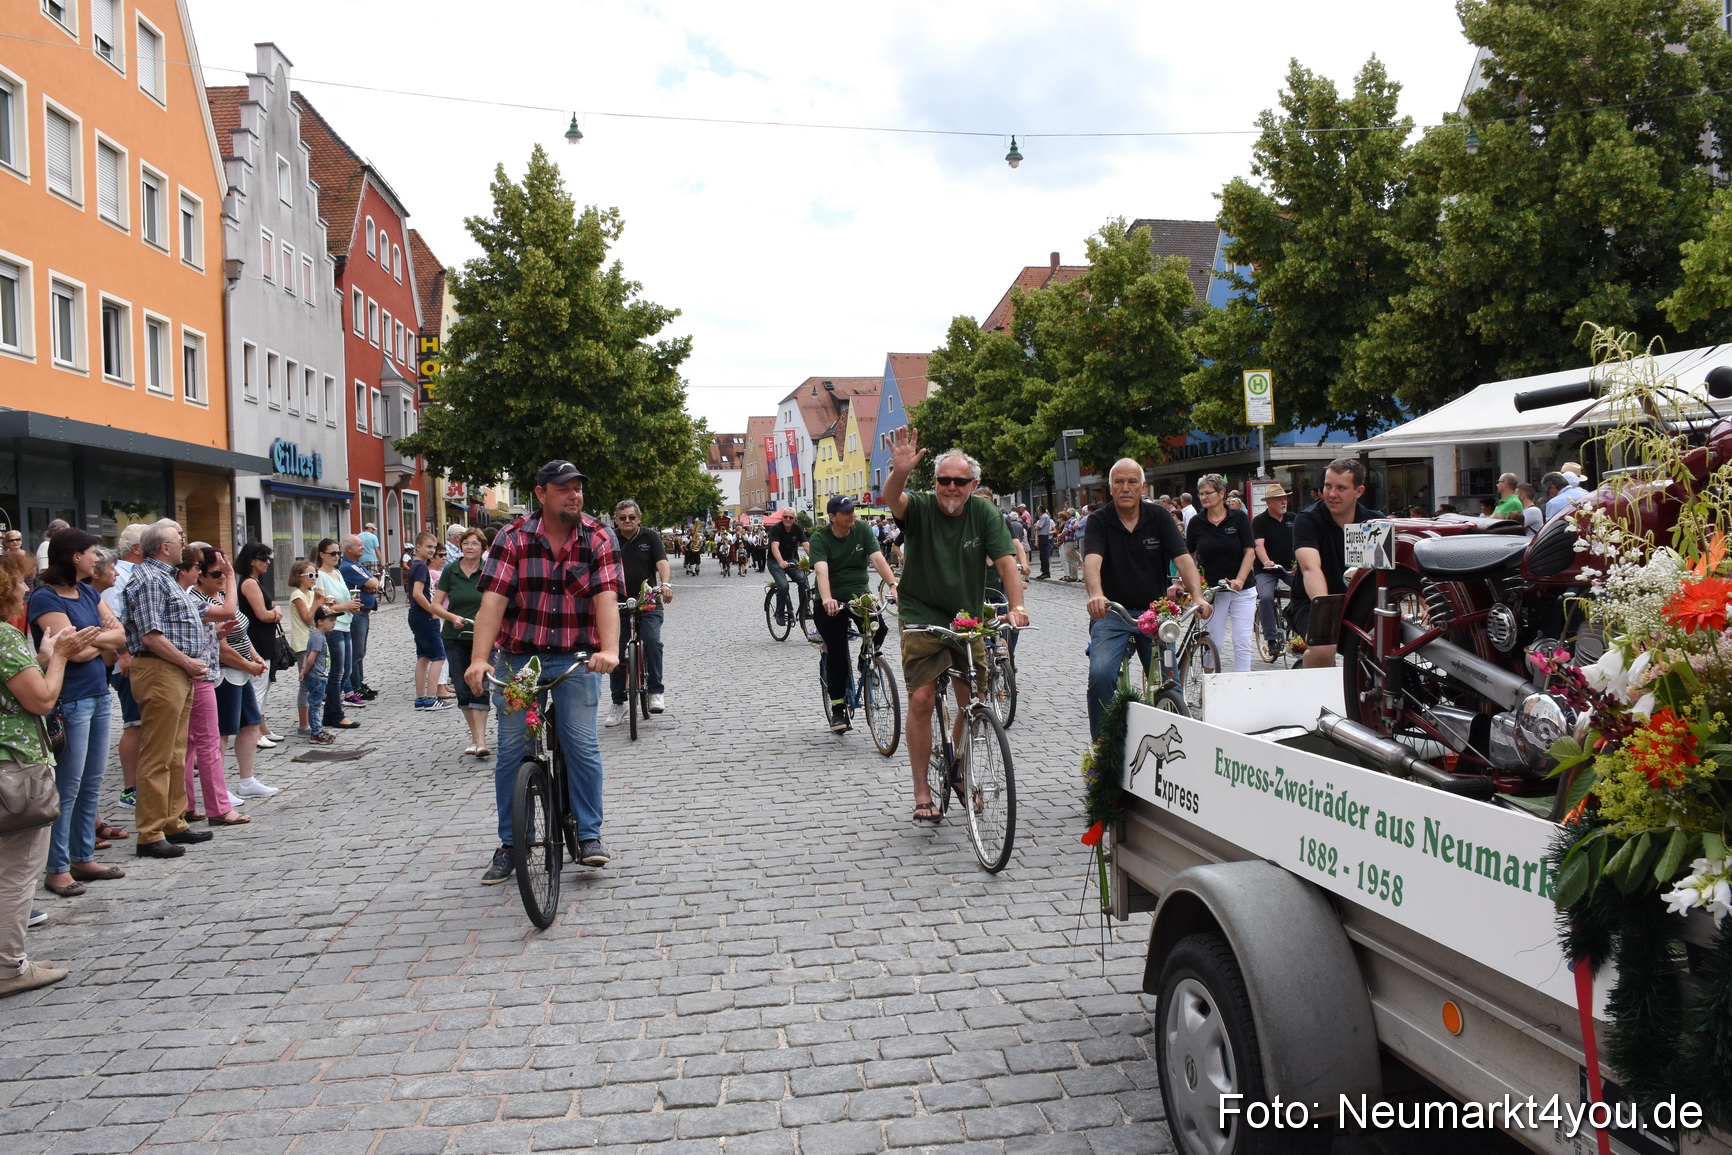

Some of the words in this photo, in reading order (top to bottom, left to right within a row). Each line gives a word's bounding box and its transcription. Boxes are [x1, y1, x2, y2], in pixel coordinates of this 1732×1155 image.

[1253, 379, 1263, 390] H
[270, 438, 314, 478] Eilles
[1345, 528, 1366, 547] Express-
[1345, 546, 1363, 563] Treffen
[1155, 759, 1199, 814] Express
[1215, 747, 1369, 831] Express-Zweiräder
[1375, 809, 1415, 848] aus
[1299, 835, 1338, 878] 1882
[1343, 865, 1350, 875] -
[1357, 861, 1403, 907] 1958
